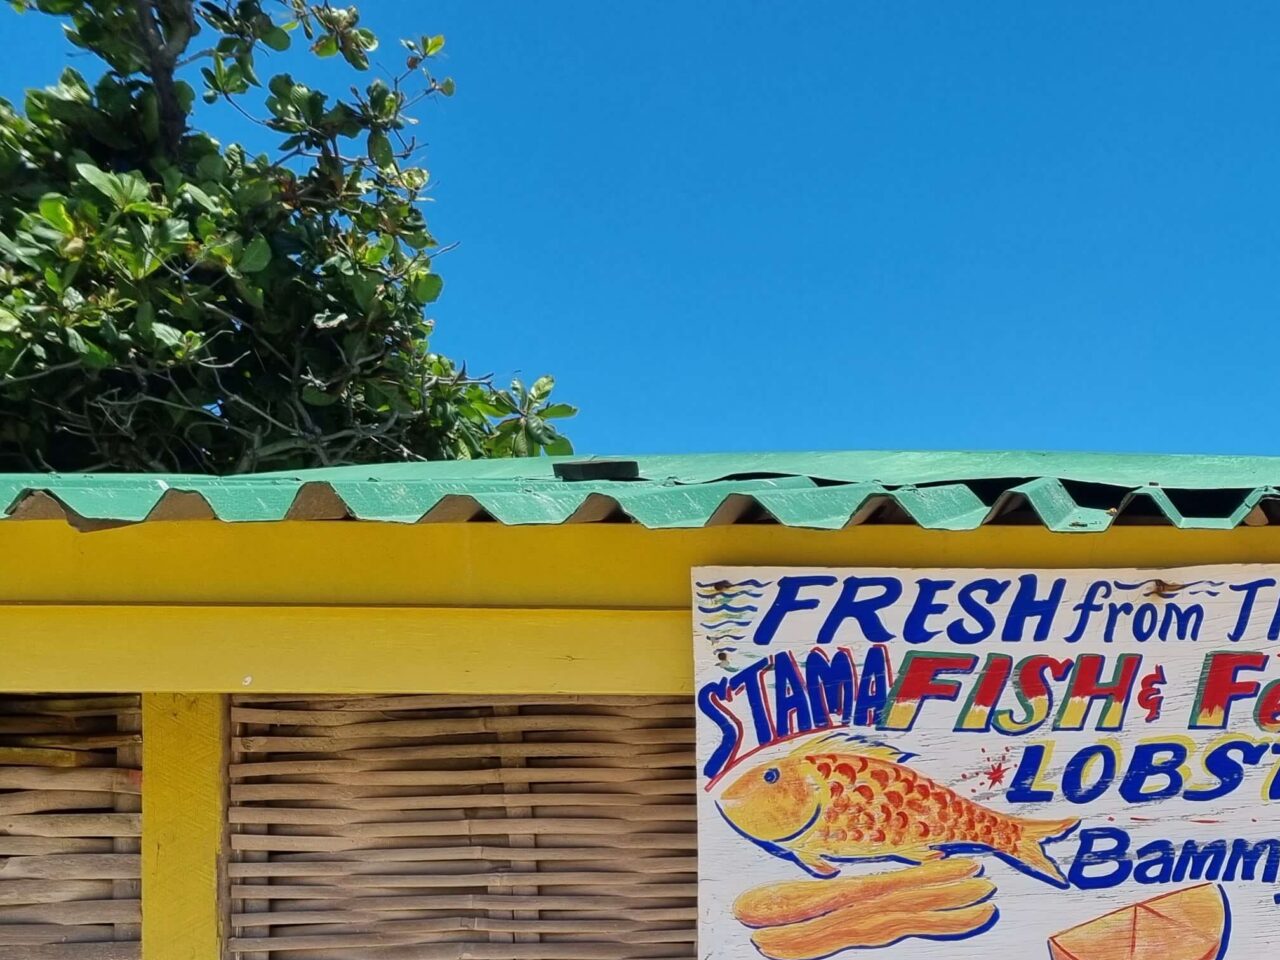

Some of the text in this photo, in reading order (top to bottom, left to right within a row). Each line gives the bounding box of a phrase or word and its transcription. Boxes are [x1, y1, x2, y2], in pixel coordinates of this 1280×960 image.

[753, 574, 1066, 645] FRESH
[1065, 580, 1203, 643] from
[875, 650, 1143, 734] FISH
[1136, 664, 1167, 723] &
